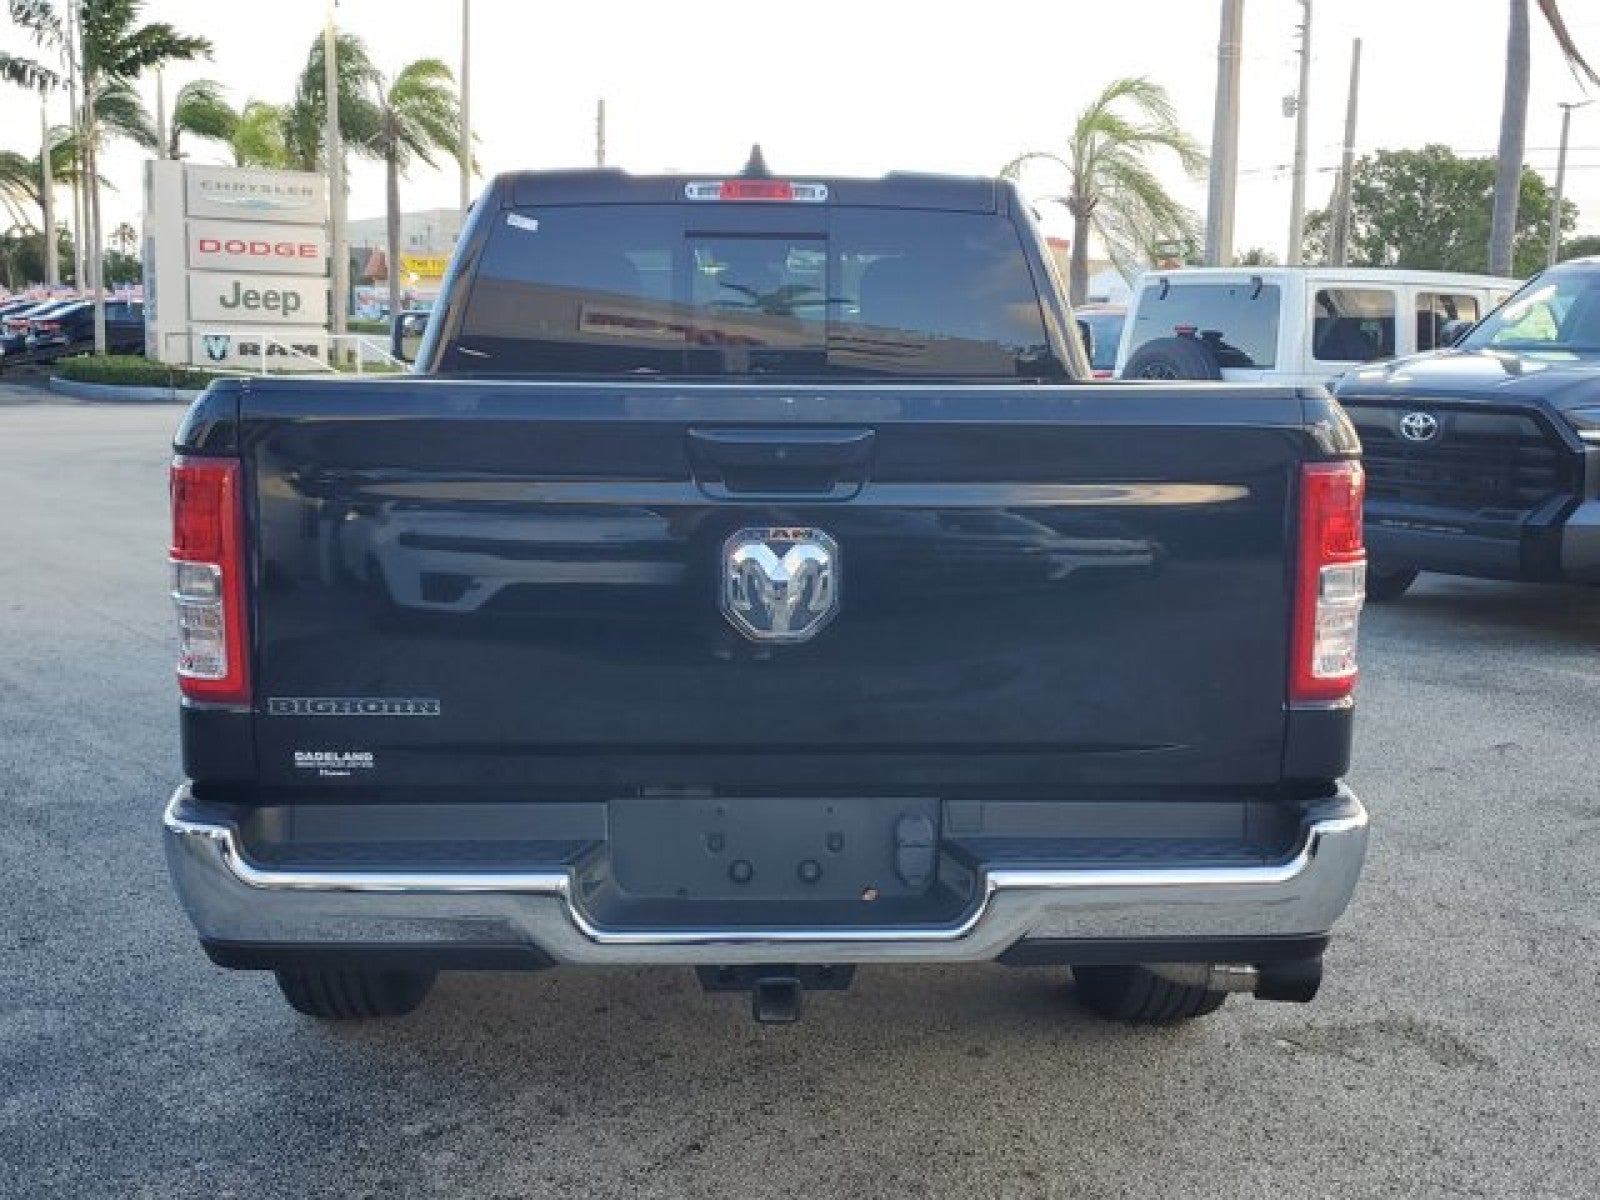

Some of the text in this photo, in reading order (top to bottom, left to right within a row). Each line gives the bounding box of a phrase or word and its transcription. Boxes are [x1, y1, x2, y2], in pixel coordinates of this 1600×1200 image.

[199, 239, 318, 258] DODGE
[219, 280, 301, 317] Jeep
[239, 341, 318, 357] RAM
